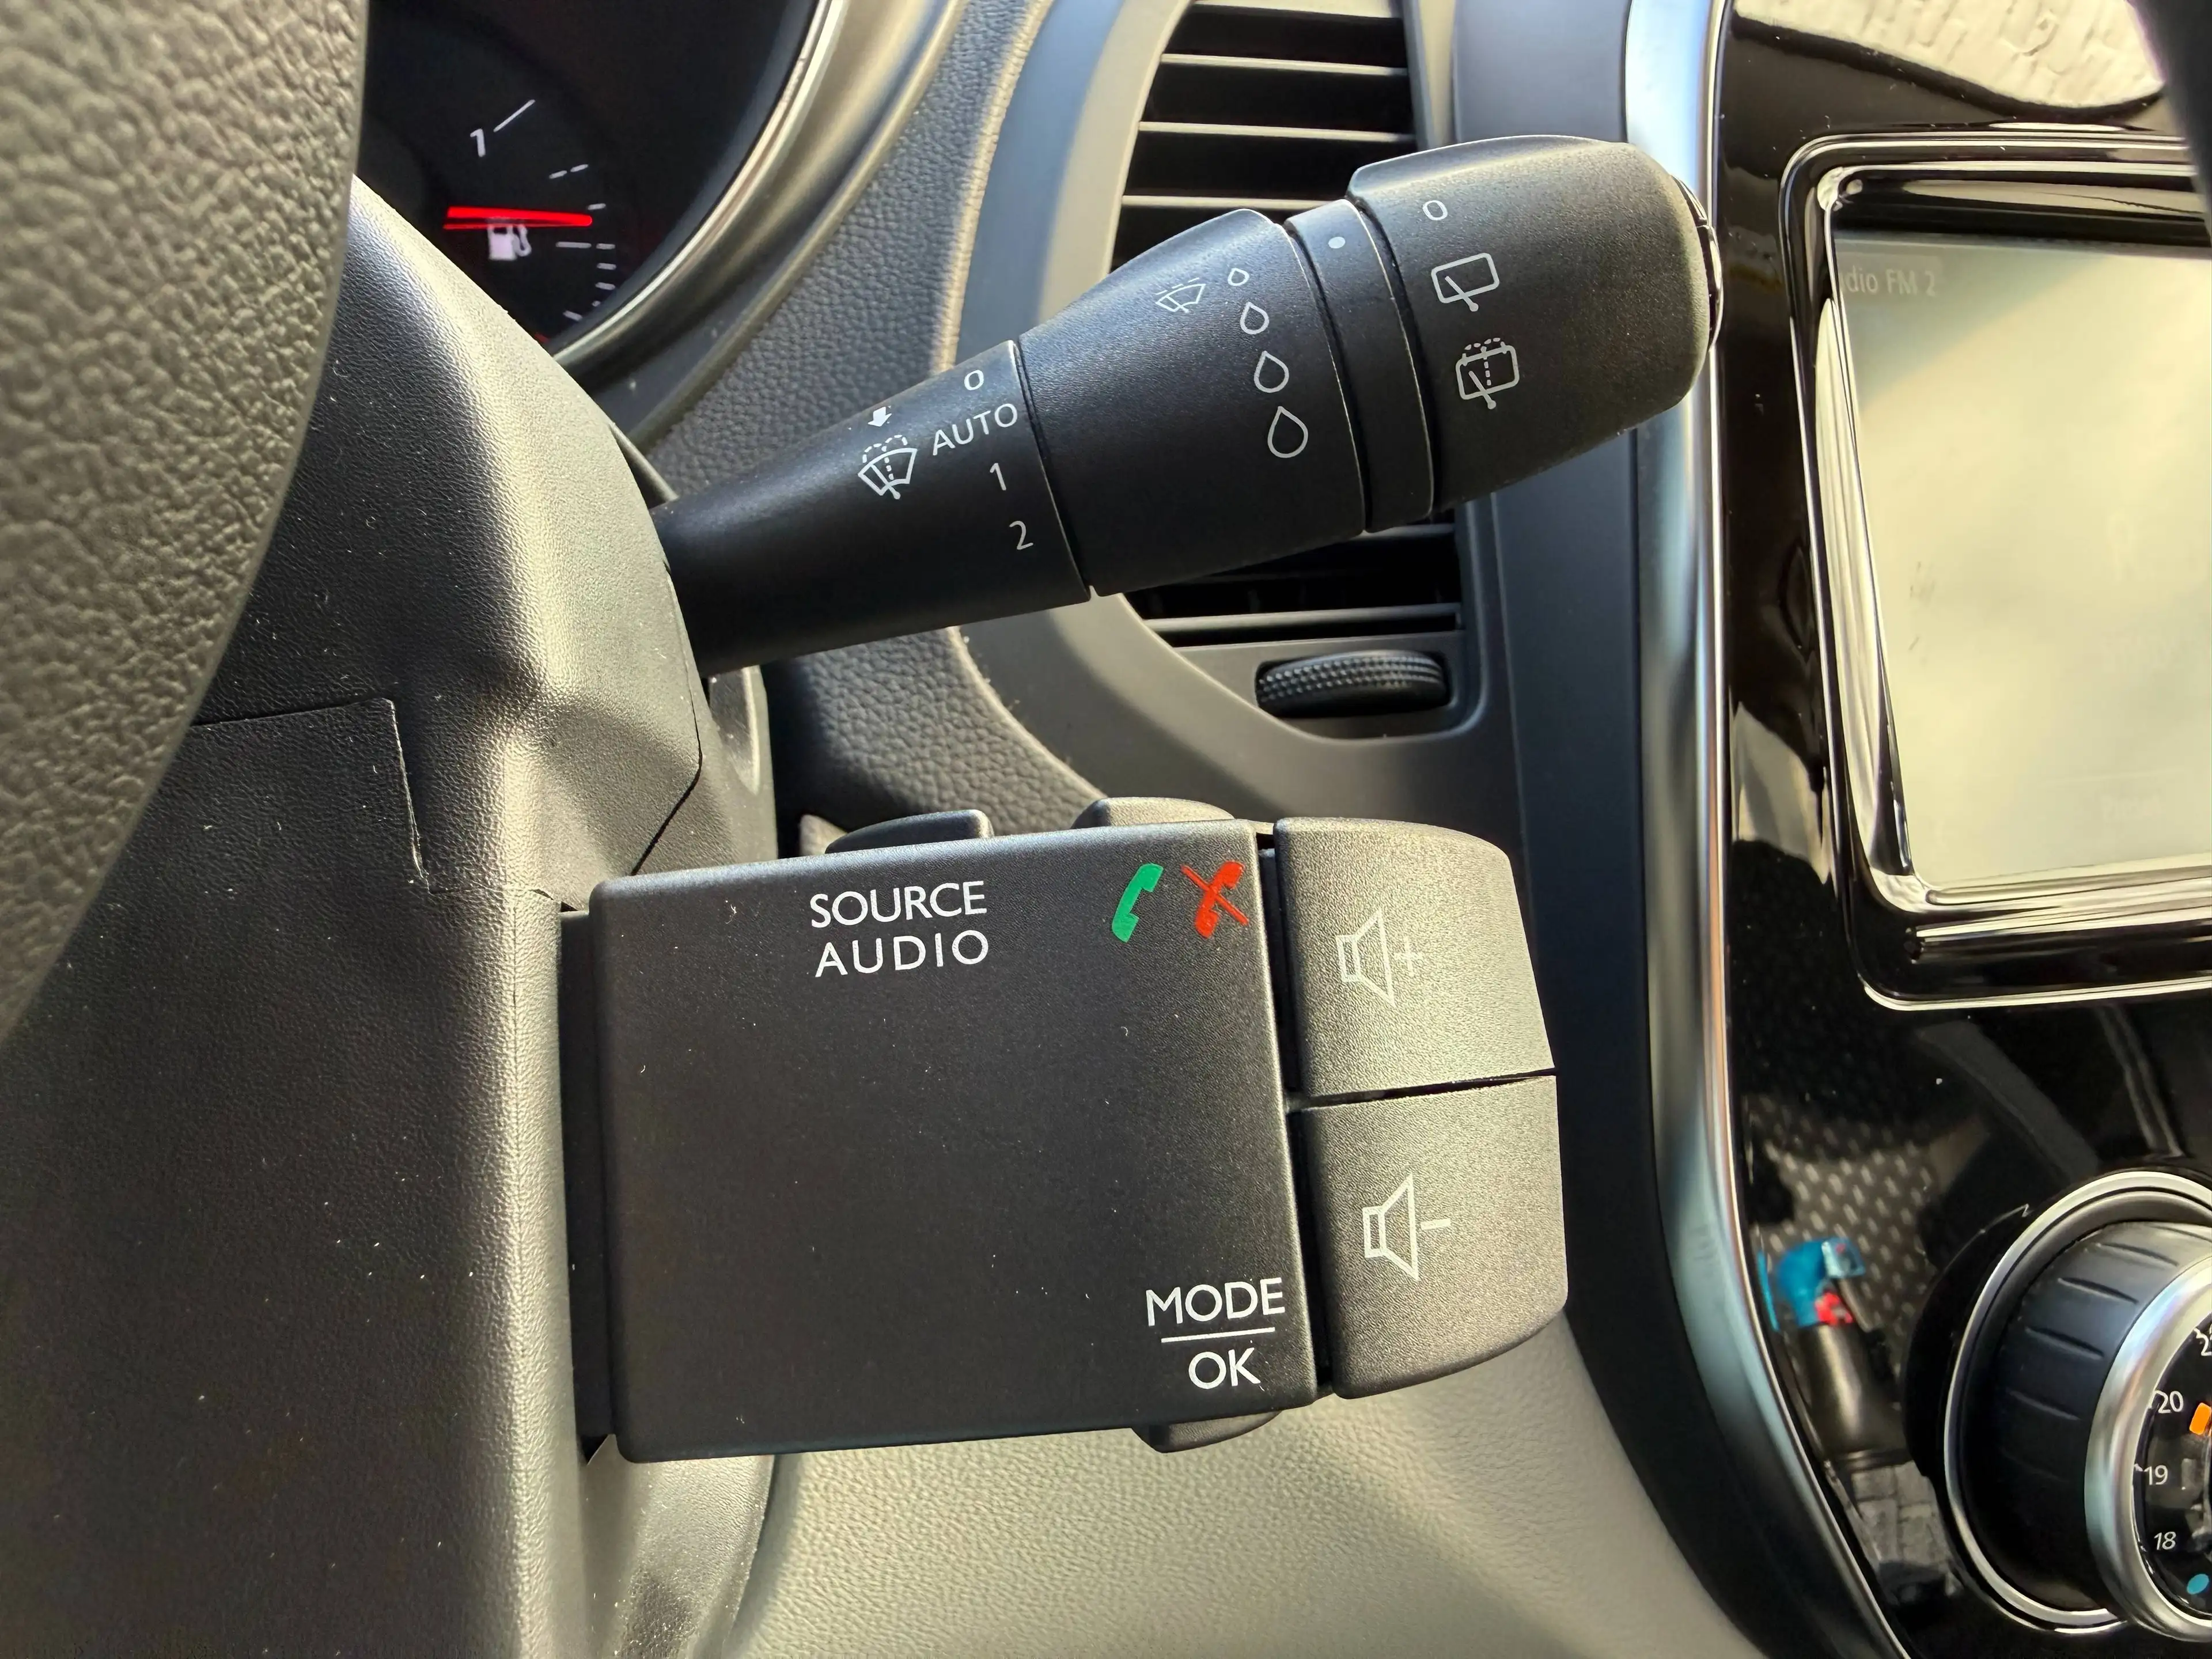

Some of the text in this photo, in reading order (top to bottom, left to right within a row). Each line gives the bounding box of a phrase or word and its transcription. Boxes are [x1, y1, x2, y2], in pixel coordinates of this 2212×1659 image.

[469, 128, 486, 157] 1
[1839, 265, 1936, 297] dio FM 2
[933, 403, 1018, 456] AUTO
[990, 463, 1006, 491] 1
[1009, 520, 1033, 550] 2
[810, 880, 988, 929] SOURCE
[815, 929, 990, 978] AUDIO
[1146, 1277, 1286, 1327] MODE
[1188, 1347, 1262, 1389] OK
[2157, 1390, 2184, 1414] 20
[2143, 1465, 2168, 1486] 19
[2154, 1531, 2176, 1550] 18
